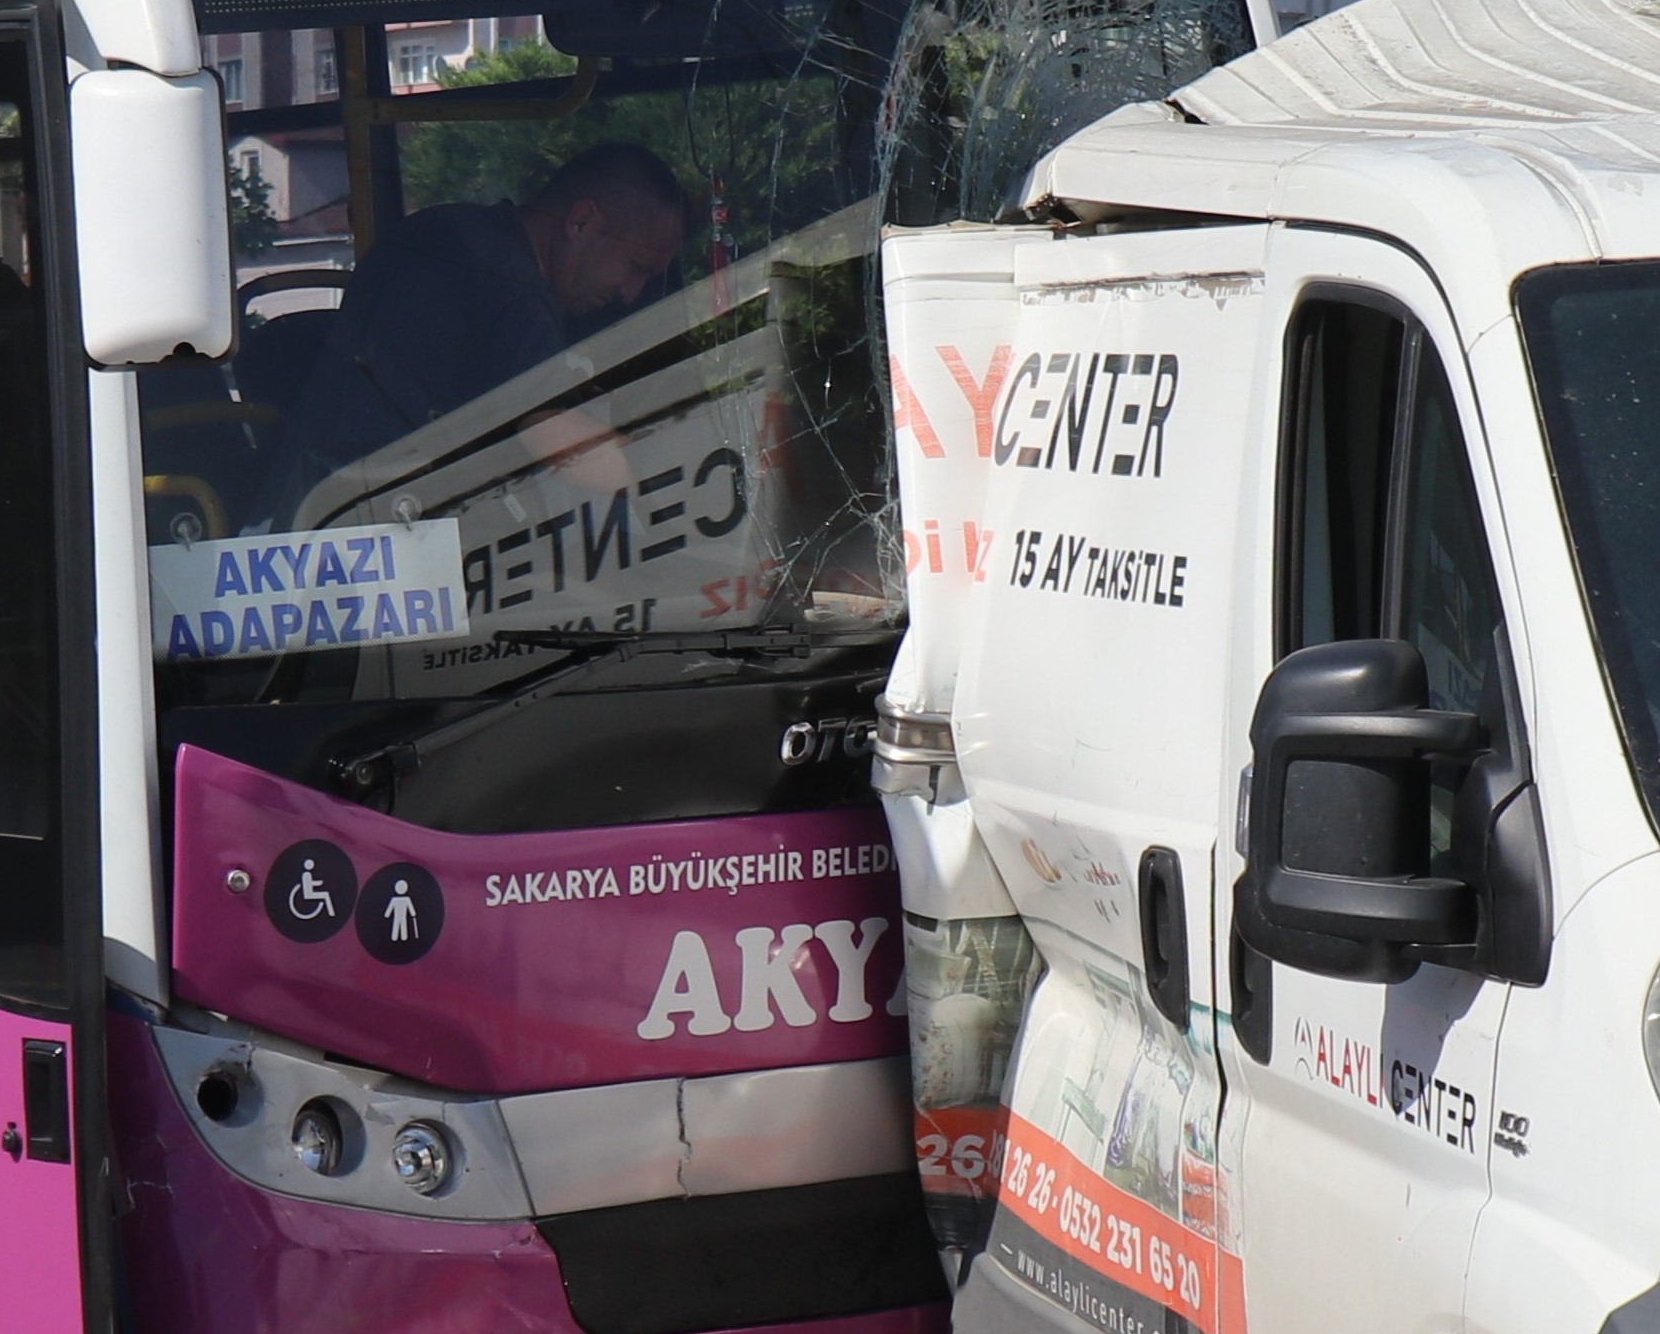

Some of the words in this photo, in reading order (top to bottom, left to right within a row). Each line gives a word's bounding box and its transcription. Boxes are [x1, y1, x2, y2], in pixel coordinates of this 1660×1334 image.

[995, 352, 1179, 479] CENTER
[214, 535, 396, 598] AKYAZI
[1010, 530, 1043, 589] 15
[1040, 534, 1087, 594] AY
[167, 587, 455, 661] ADAPAZARI
[485, 867, 620, 907] SAKARYA
[629, 845, 803, 895] BÜYÜKŞEHİR
[1316, 1025, 1385, 1110] ALAYLI
[1392, 1059, 1476, 1154] CENTER
[1007, 1147, 1032, 1198] 26
[1027, 1163, 1056, 1214] 26
[1060, 1186, 1101, 1253] 0532
[1107, 1214, 1143, 1275] 231
[1149, 1236, 1174, 1291] 65
[1178, 1254, 1202, 1310] 20
